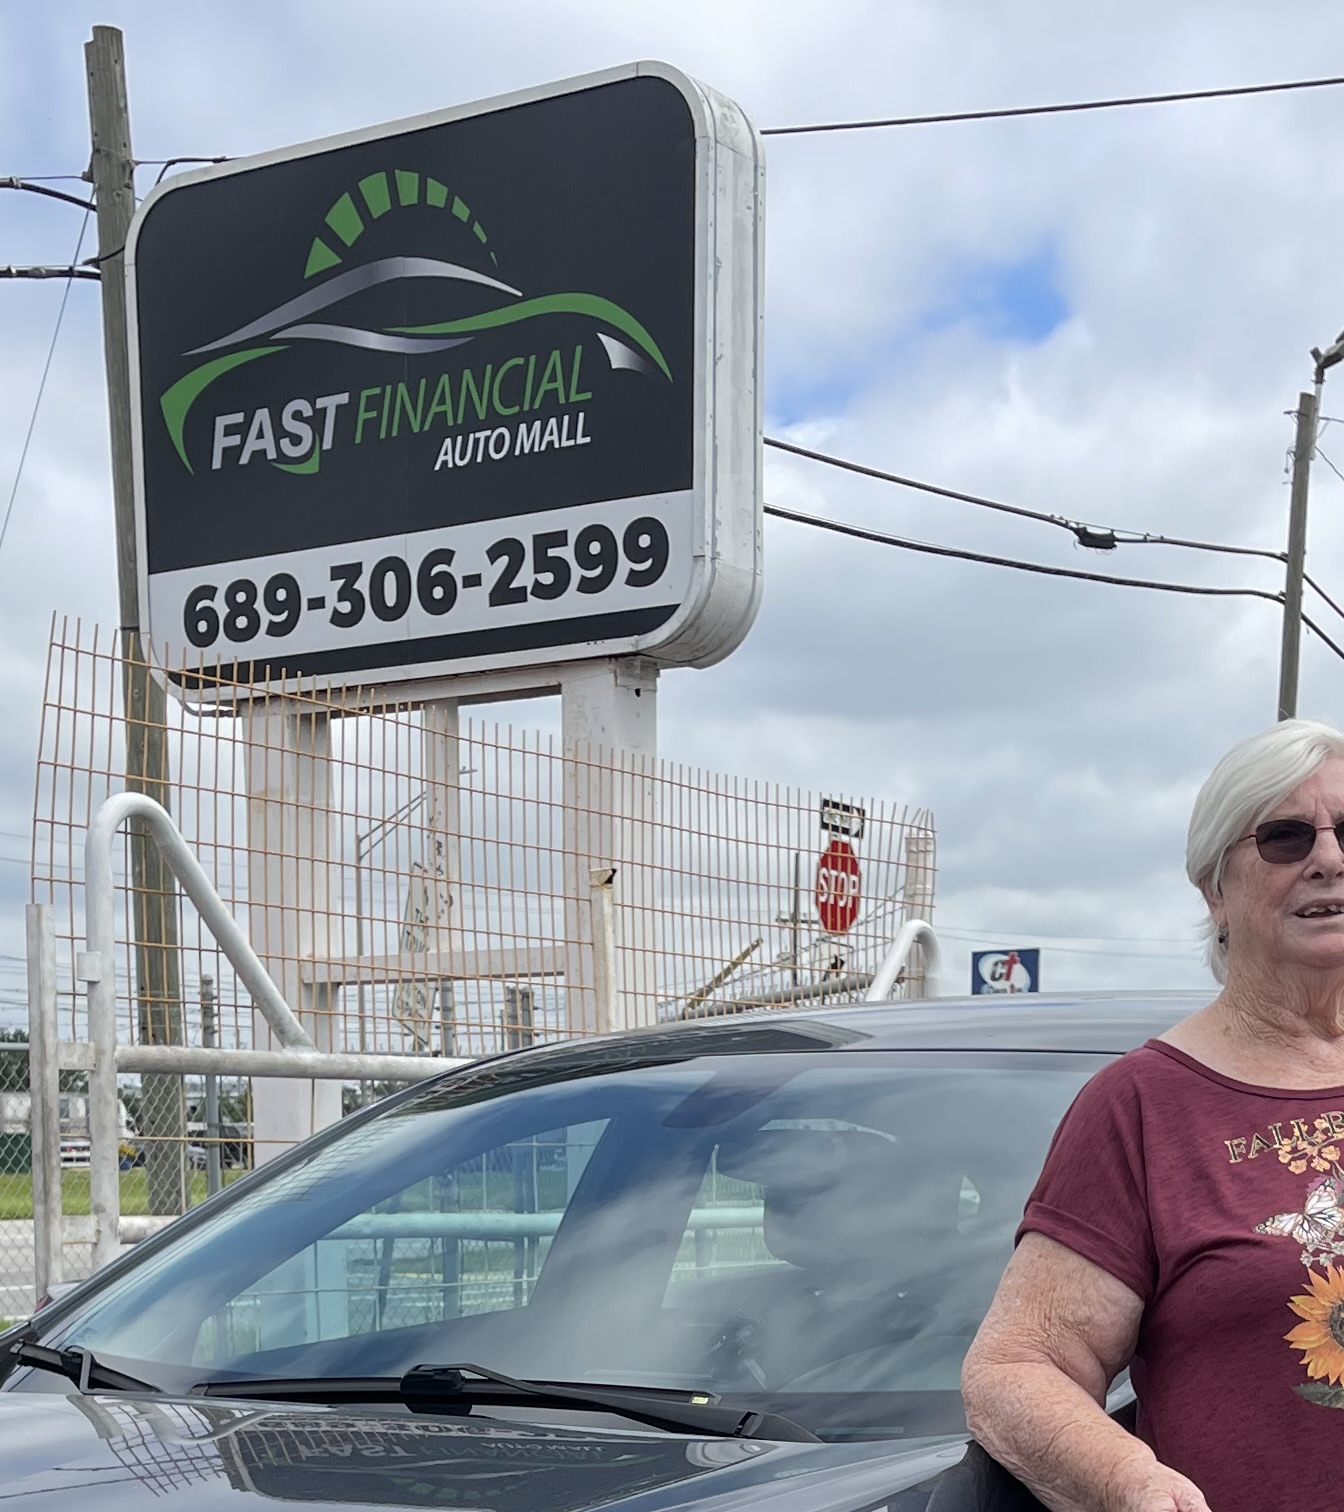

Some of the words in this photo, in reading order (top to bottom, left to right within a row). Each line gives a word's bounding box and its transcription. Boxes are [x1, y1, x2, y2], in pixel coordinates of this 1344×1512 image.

[211, 391, 350, 471] FAST
[354, 344, 593, 445] FINANCIAL
[433, 426, 511, 472] AUTO
[513, 411, 592, 457] MALL
[183, 515, 670, 649] 689-306-2599
[818, 866, 860, 910] STOP
[1223, 1117, 1325, 1164] FALL
